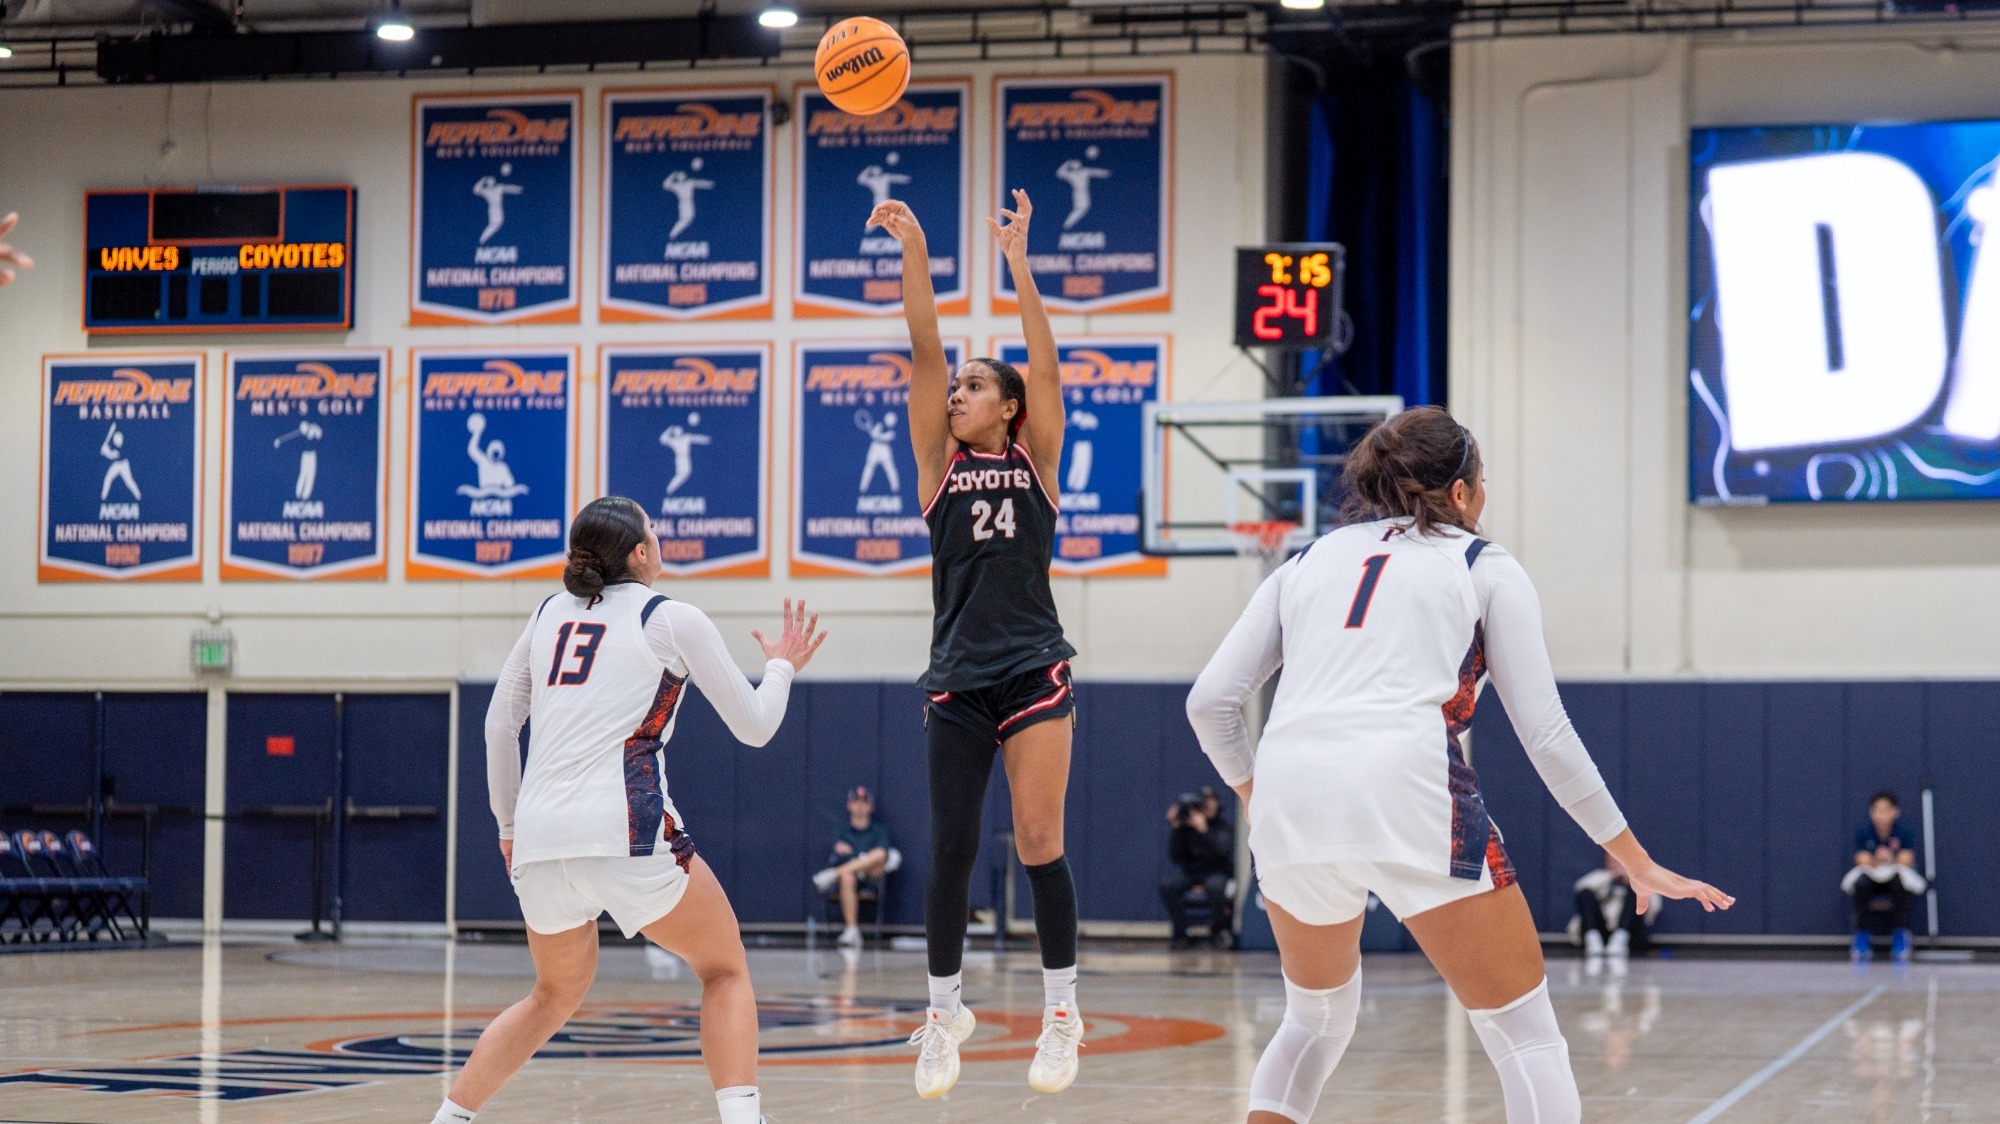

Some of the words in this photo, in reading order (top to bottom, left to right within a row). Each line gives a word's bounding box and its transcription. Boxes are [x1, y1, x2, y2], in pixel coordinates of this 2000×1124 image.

[825, 46, 885, 82] Wilson
[1007, 89, 1158, 127] PEPPERDINE
[425, 109, 569, 147] PEPPERDINE
[614, 103, 762, 140] PEPPERDINE
[664, 241, 710, 260] NCAA
[1058, 231, 1106, 250] NCAA
[101, 246, 179, 271] WAVES
[239, 243, 344, 269] COYOTES
[475, 246, 518, 264] NCAA
[1074, 252, 1155, 272] CHAMPIONS
[191, 256, 239, 276] PERIOD
[427, 267, 487, 287] NATIONAL
[490, 265, 565, 286] CHAMPIONS
[616, 263, 677, 283] NATIONAL
[680, 261, 758, 281] CHAMPIONS
[809, 258, 873, 279] NATIONAL
[1253, 284, 1318, 340] 24
[54, 368, 193, 405] PEPPERDINE
[236, 362, 377, 400] PEPPERDINE
[423, 360, 565, 396] PEPPERDINE
[612, 357, 758, 395] PEPPERDINE
[425, 397, 467, 411] MEN'S
[473, 396, 521, 410] WATER
[527, 396, 565, 410] POLO
[820, 391, 875, 406] MEN'S
[1091, 387, 1144, 404] GOLF
[79, 403, 171, 420] BASEBALL
[251, 400, 308, 416] MEN'S
[318, 399, 364, 416] GOLF
[948, 467, 1032, 494] COYOTES
[99, 502, 139, 521] NCAA
[282, 500, 324, 519] NCAA
[470, 499, 513, 517] NCAA
[661, 497, 706, 515] NCAA
[856, 495, 903, 514] NCAA
[424, 520, 484, 540] NATIONAL
[486, 519, 561, 539] CHAMPIONS
[677, 516, 754, 537] CHAMPIONS
[807, 517, 869, 538] NATIONAL
[971, 498, 1016, 541] 24
[55, 523, 113, 543] NATIONAL
[116, 522, 188, 542] CHAMPIONS
[238, 522, 296, 541] NATIONAL
[299, 521, 372, 541] CHAMPIONS
[475, 541, 512, 563] 1997
[1344, 553, 1392, 629] 1
[547, 621, 607, 687] 13
